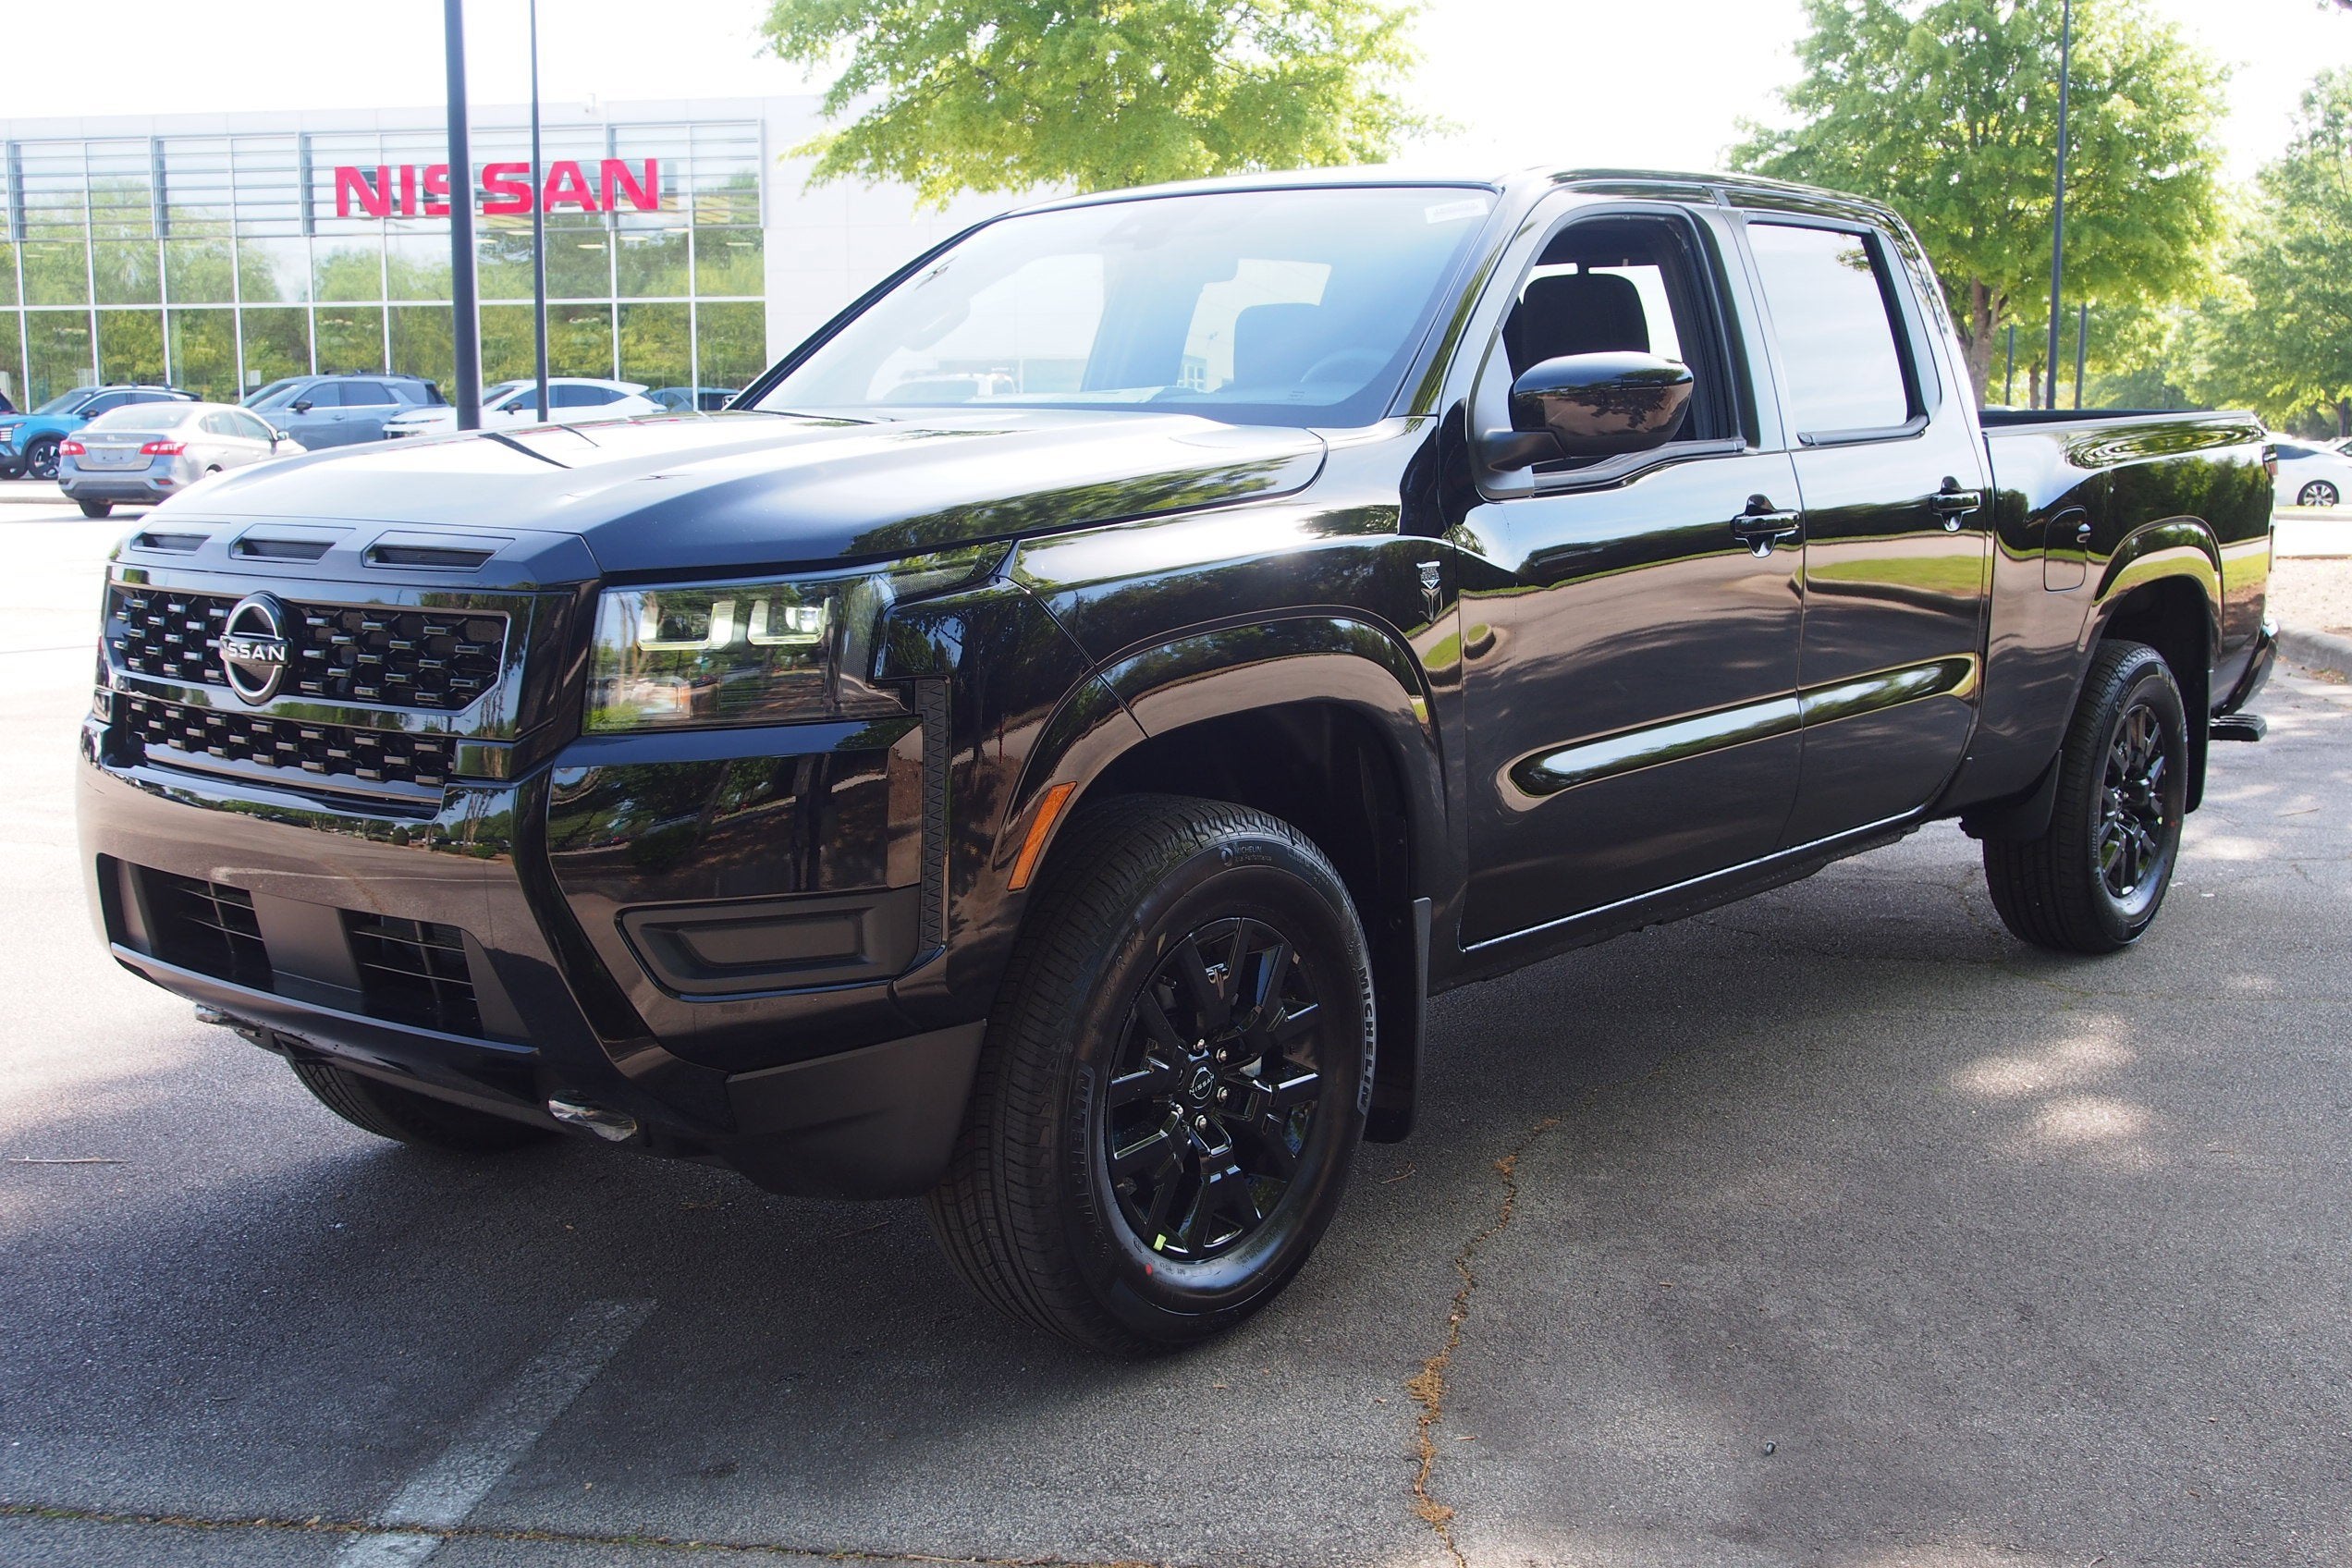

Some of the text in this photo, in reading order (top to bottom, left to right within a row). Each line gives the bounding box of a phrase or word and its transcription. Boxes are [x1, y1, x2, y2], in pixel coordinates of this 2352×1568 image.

[335, 158, 660, 218] NISSAN
[223, 641, 286, 661] SSAN
[1357, 966, 1374, 1108] MICHELIN
[1188, 1073, 1215, 1096] NISSAN
